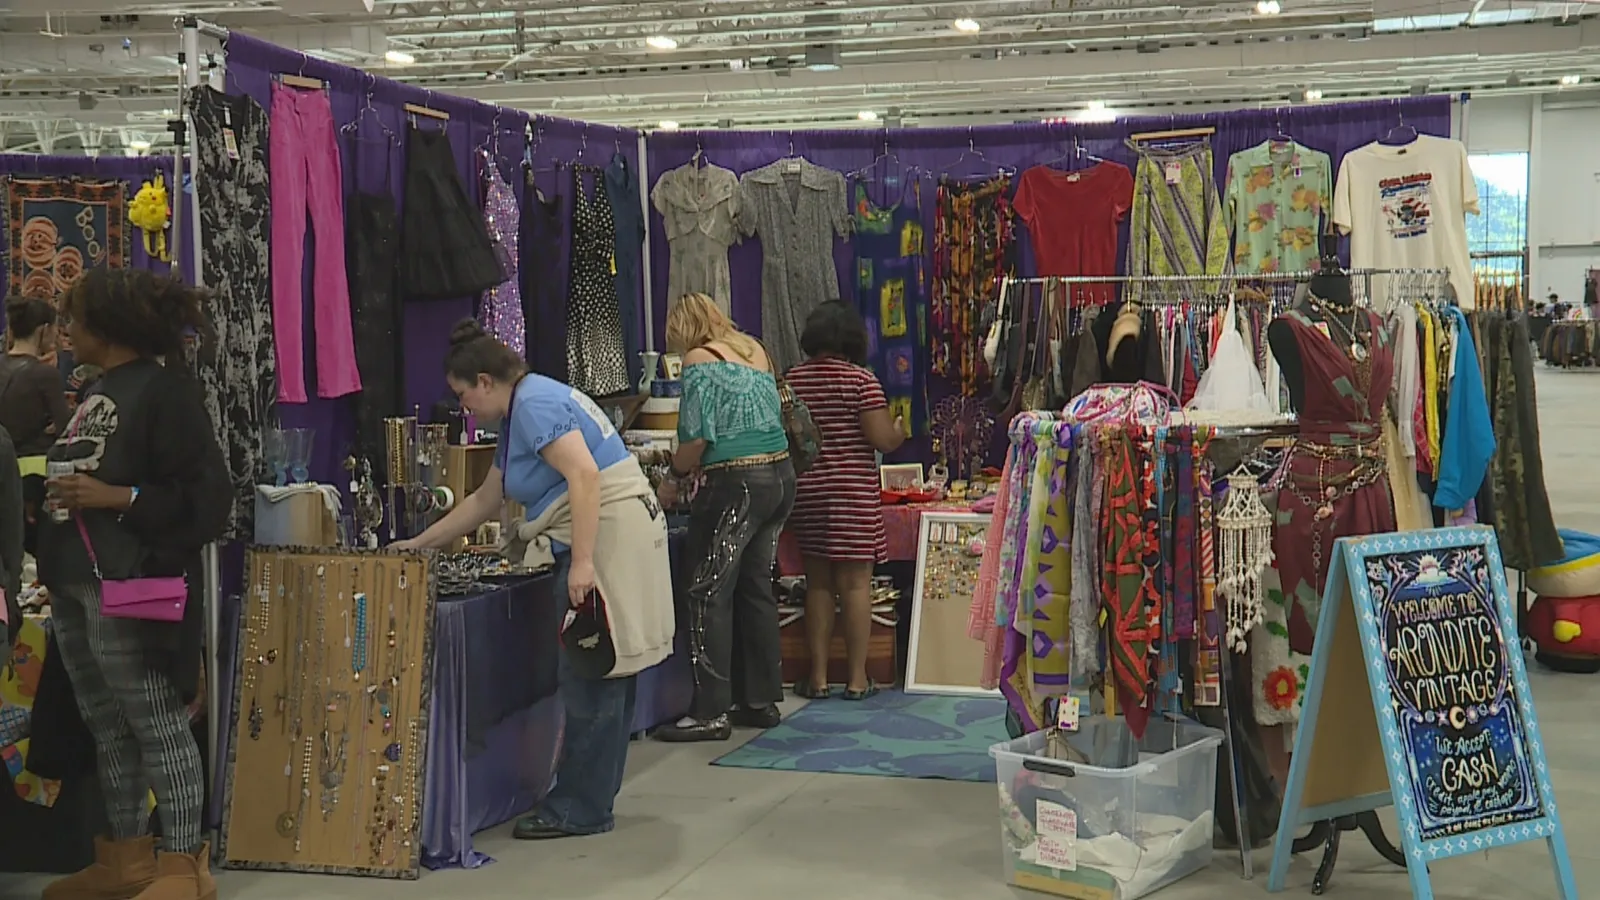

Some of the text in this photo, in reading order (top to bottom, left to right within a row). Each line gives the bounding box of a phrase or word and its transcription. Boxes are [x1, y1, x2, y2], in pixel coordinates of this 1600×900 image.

[1391, 591, 1477, 625] WELCOME TO
[1389, 616, 1496, 680] ARONDITE
[1404, 669, 1496, 711] VINTAGE
[1442, 747, 1499, 792] CASH
